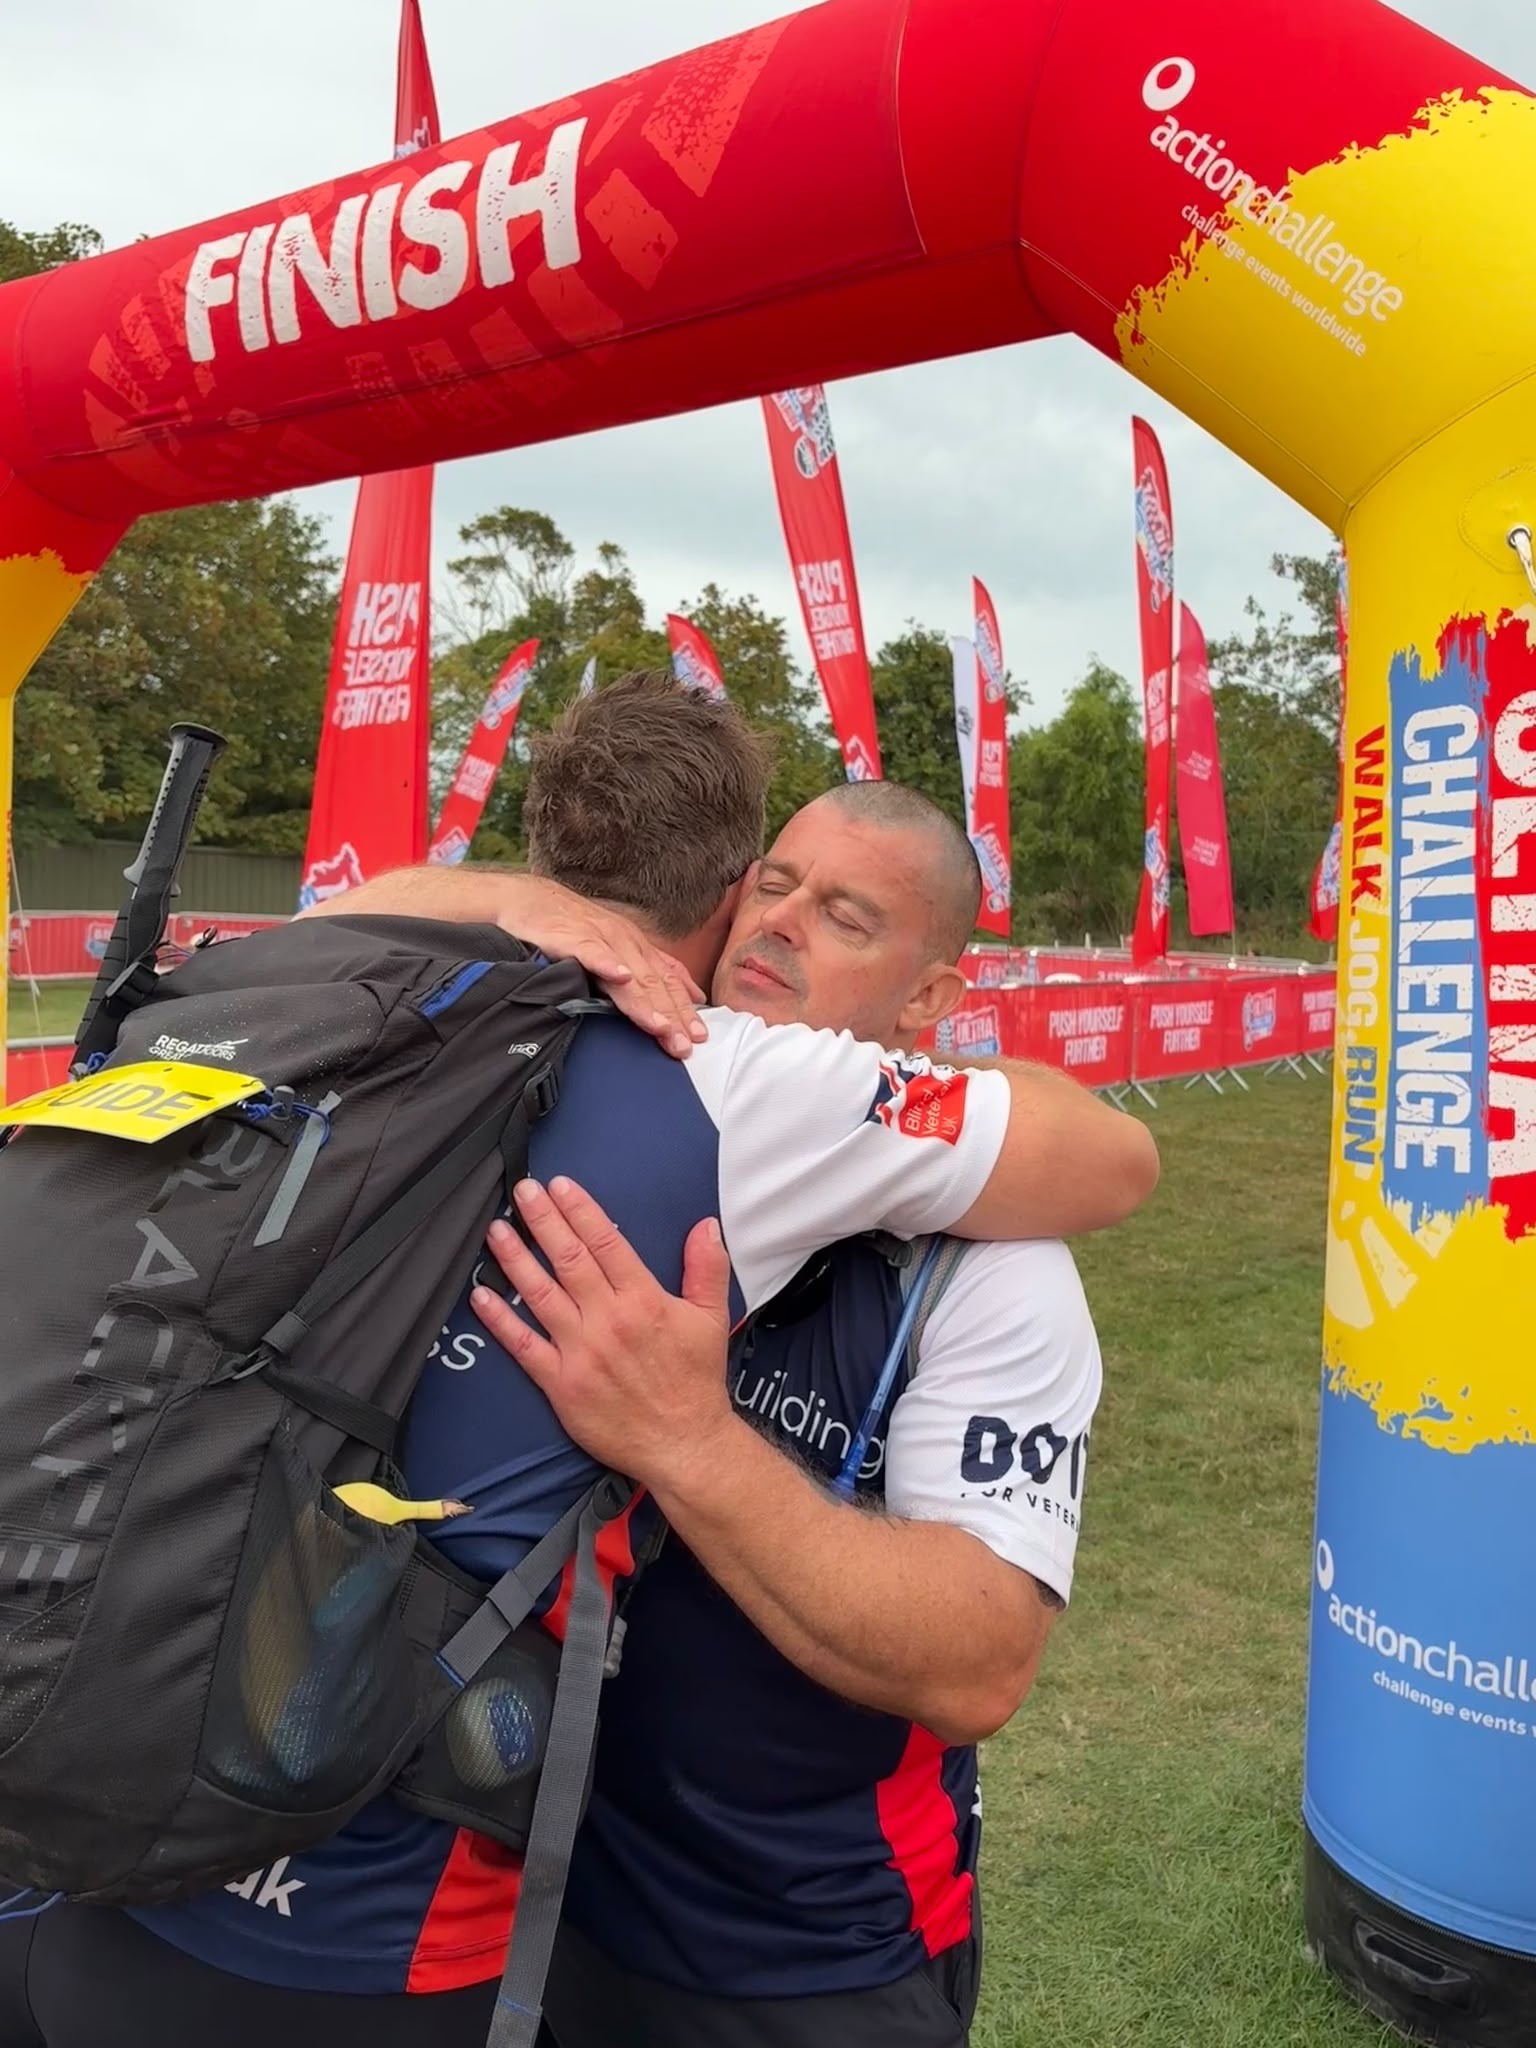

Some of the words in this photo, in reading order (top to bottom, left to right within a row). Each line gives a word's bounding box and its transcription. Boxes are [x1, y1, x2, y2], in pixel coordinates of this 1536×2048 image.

[184, 118, 587, 362] FINISH
[1149, 114, 1404, 322] actionchallenge
[1181, 204, 1246, 263] challenge
[1245, 255, 1292, 298] events
[1291, 292, 1367, 357] worldwide
[1394, 704, 1478, 1175] CHALLENGE
[941, 1115, 959, 1136] UK
[1343, 1046, 1378, 1167] RUN
[734, 1369, 886, 1479] uilding
[1373, 1670, 1455, 1716] challenge
[1459, 1706, 1527, 1736] events
